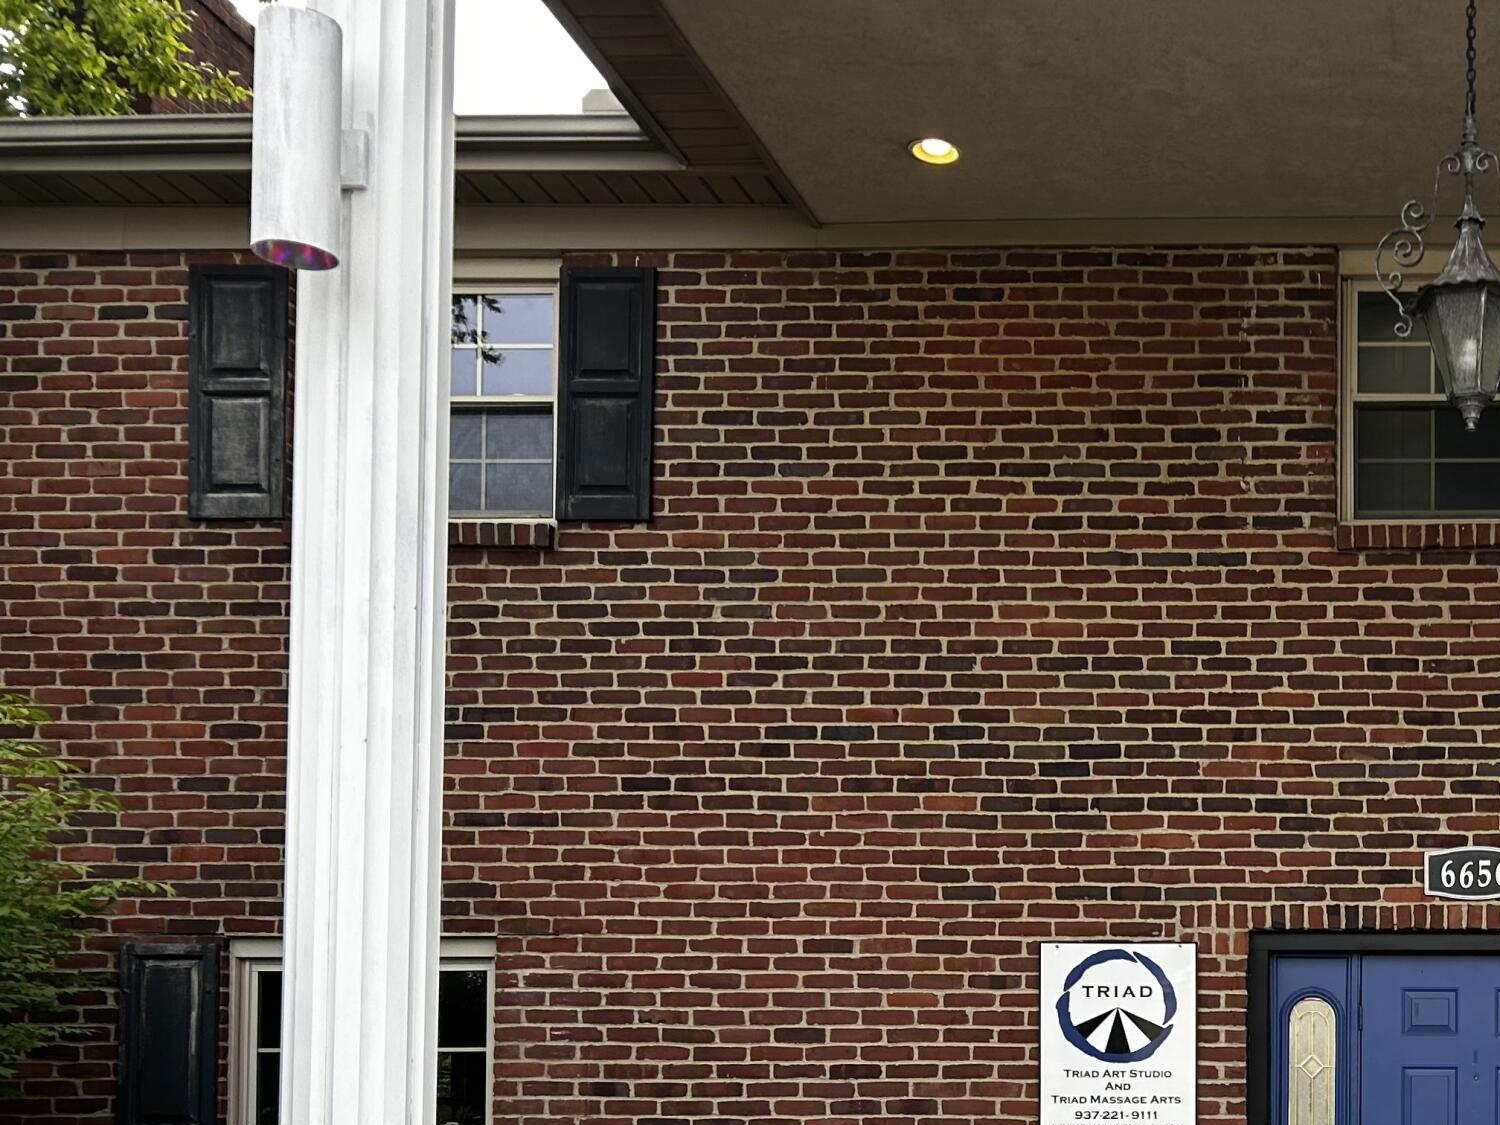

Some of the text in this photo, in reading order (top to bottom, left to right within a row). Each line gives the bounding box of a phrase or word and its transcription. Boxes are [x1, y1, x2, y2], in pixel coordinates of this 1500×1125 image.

[1082, 985, 1154, 998] TRIAD
[1064, 1069, 1172, 1078] TRIAD ART STUDIO
[1105, 1082, 1131, 1091] AND
[1051, 1095, 1182, 1104] TRIAD MASSAGE ARTS
